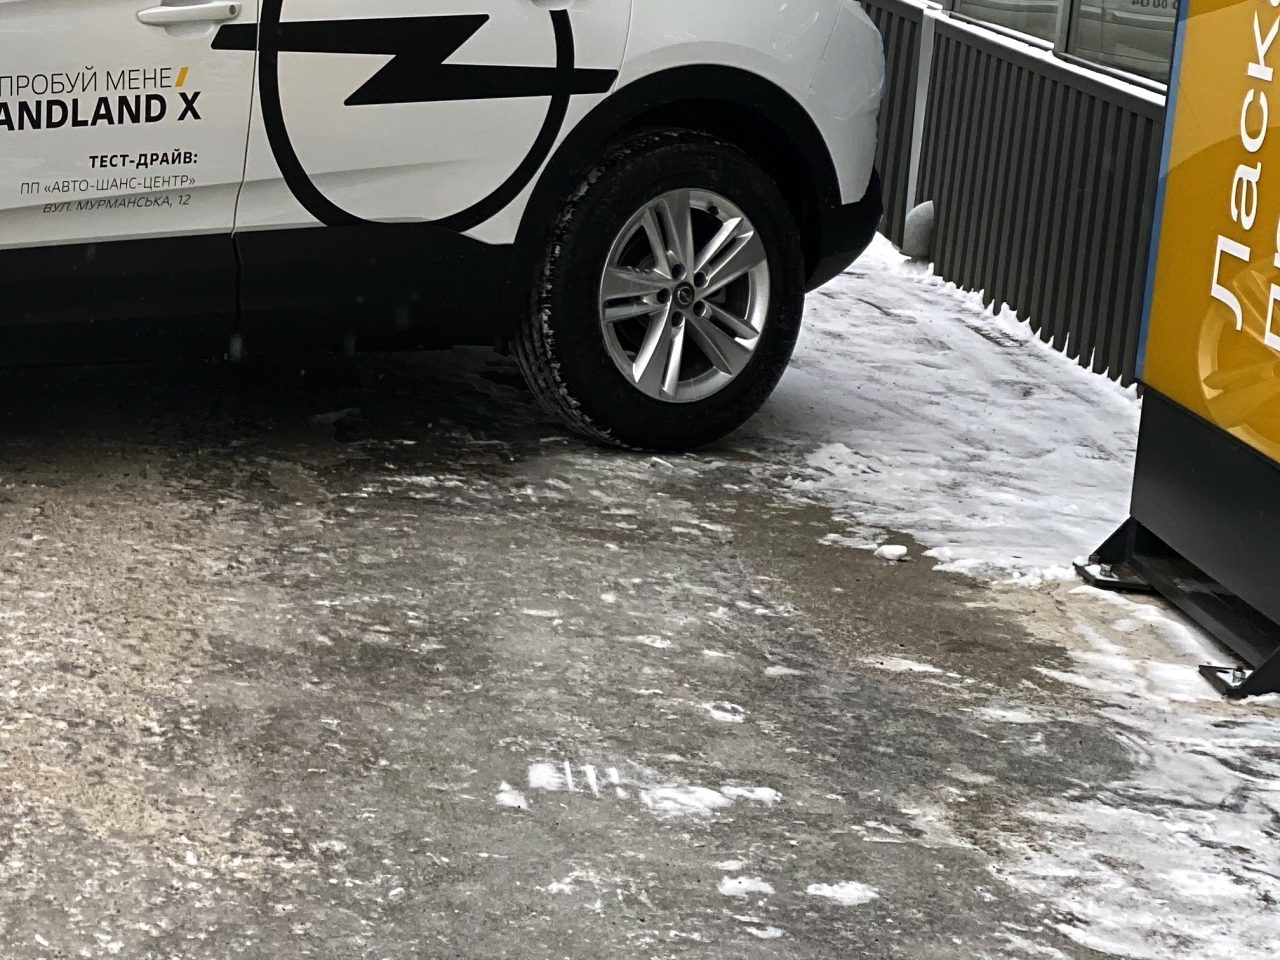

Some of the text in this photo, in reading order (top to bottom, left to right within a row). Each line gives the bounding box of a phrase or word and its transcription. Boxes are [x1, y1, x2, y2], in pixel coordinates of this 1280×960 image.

[106, 67, 172, 91] МЕНЕ
[177, 91, 201, 121] X
[89, 148, 198, 169] ТЕСТ-ДРАЙВ:
[20, 174, 196, 195] ПП «АВТО-ШАНС-ЦЕНТР»
[42, 194, 192, 214] ВУЛ. МУРМАНСЬКА, 12
